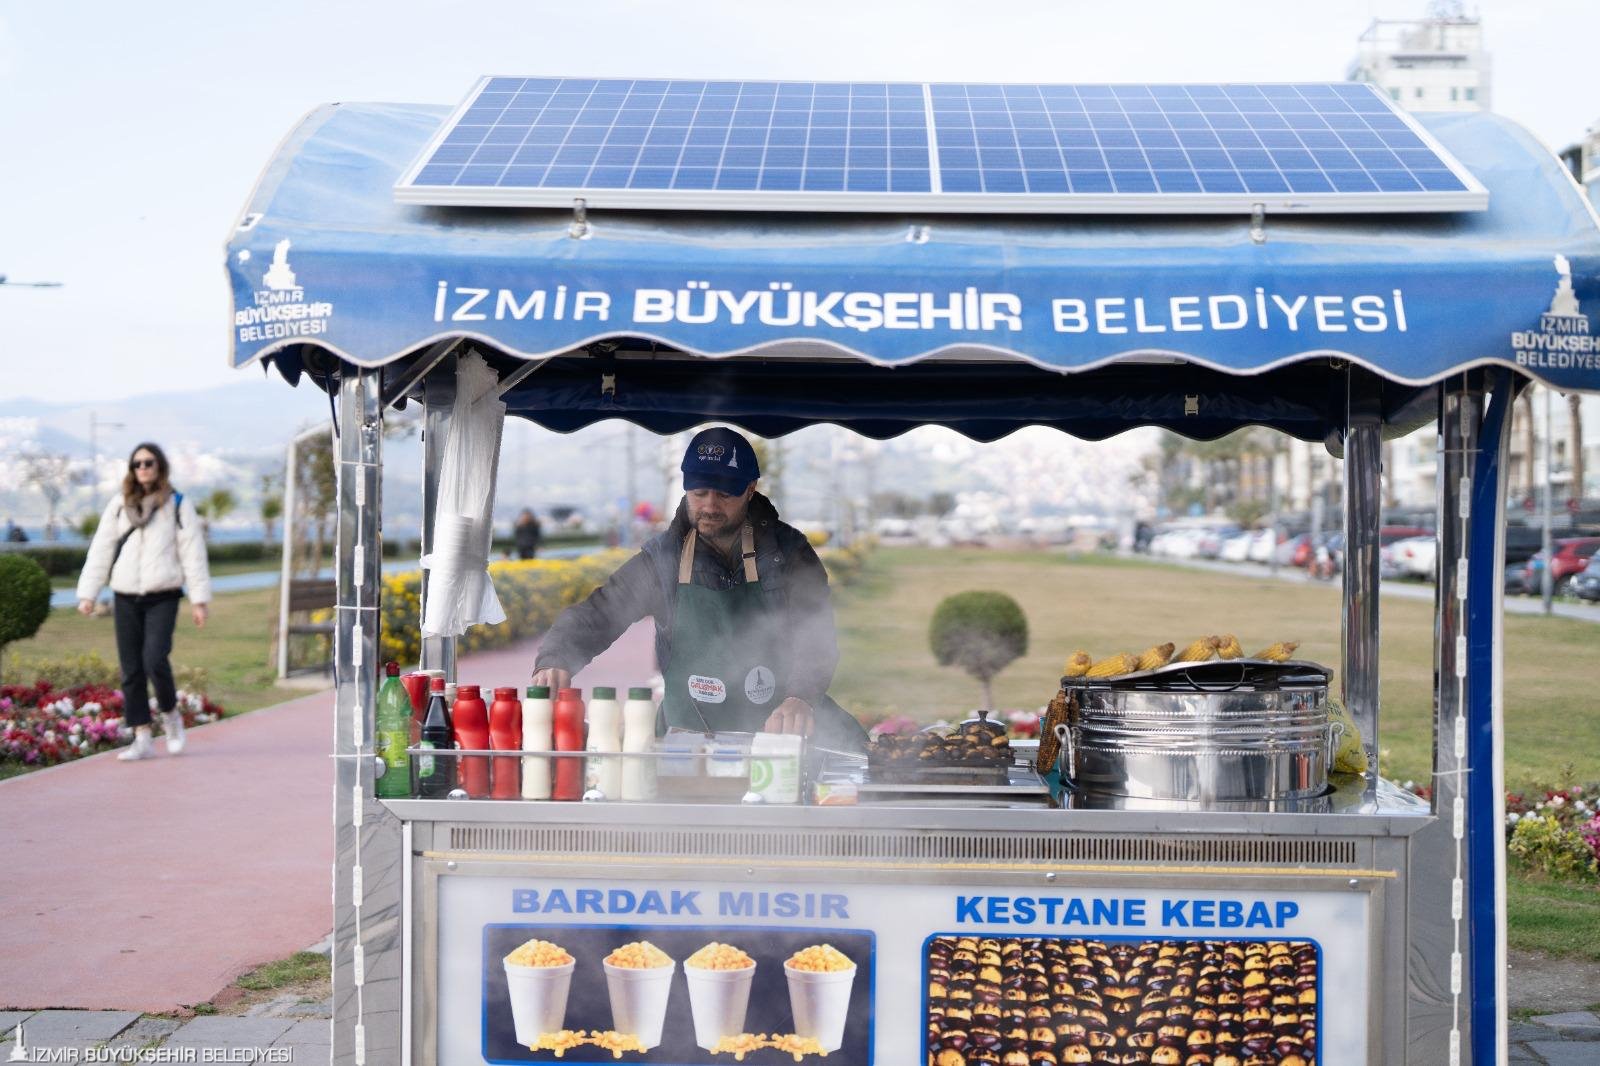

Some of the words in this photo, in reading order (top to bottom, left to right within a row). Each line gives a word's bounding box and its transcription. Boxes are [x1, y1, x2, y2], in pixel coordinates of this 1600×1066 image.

[433, 280, 612, 323] İZMİR
[632, 280, 1023, 332] BÜYÜKŞEHİR
[1052, 286, 1408, 334] BELEDİYESİ
[512, 888, 703, 916] BARDAK
[718, 890, 850, 919] MISIR
[955, 895, 1147, 927] KESTANE
[1162, 899, 1299, 929] KEBAP
